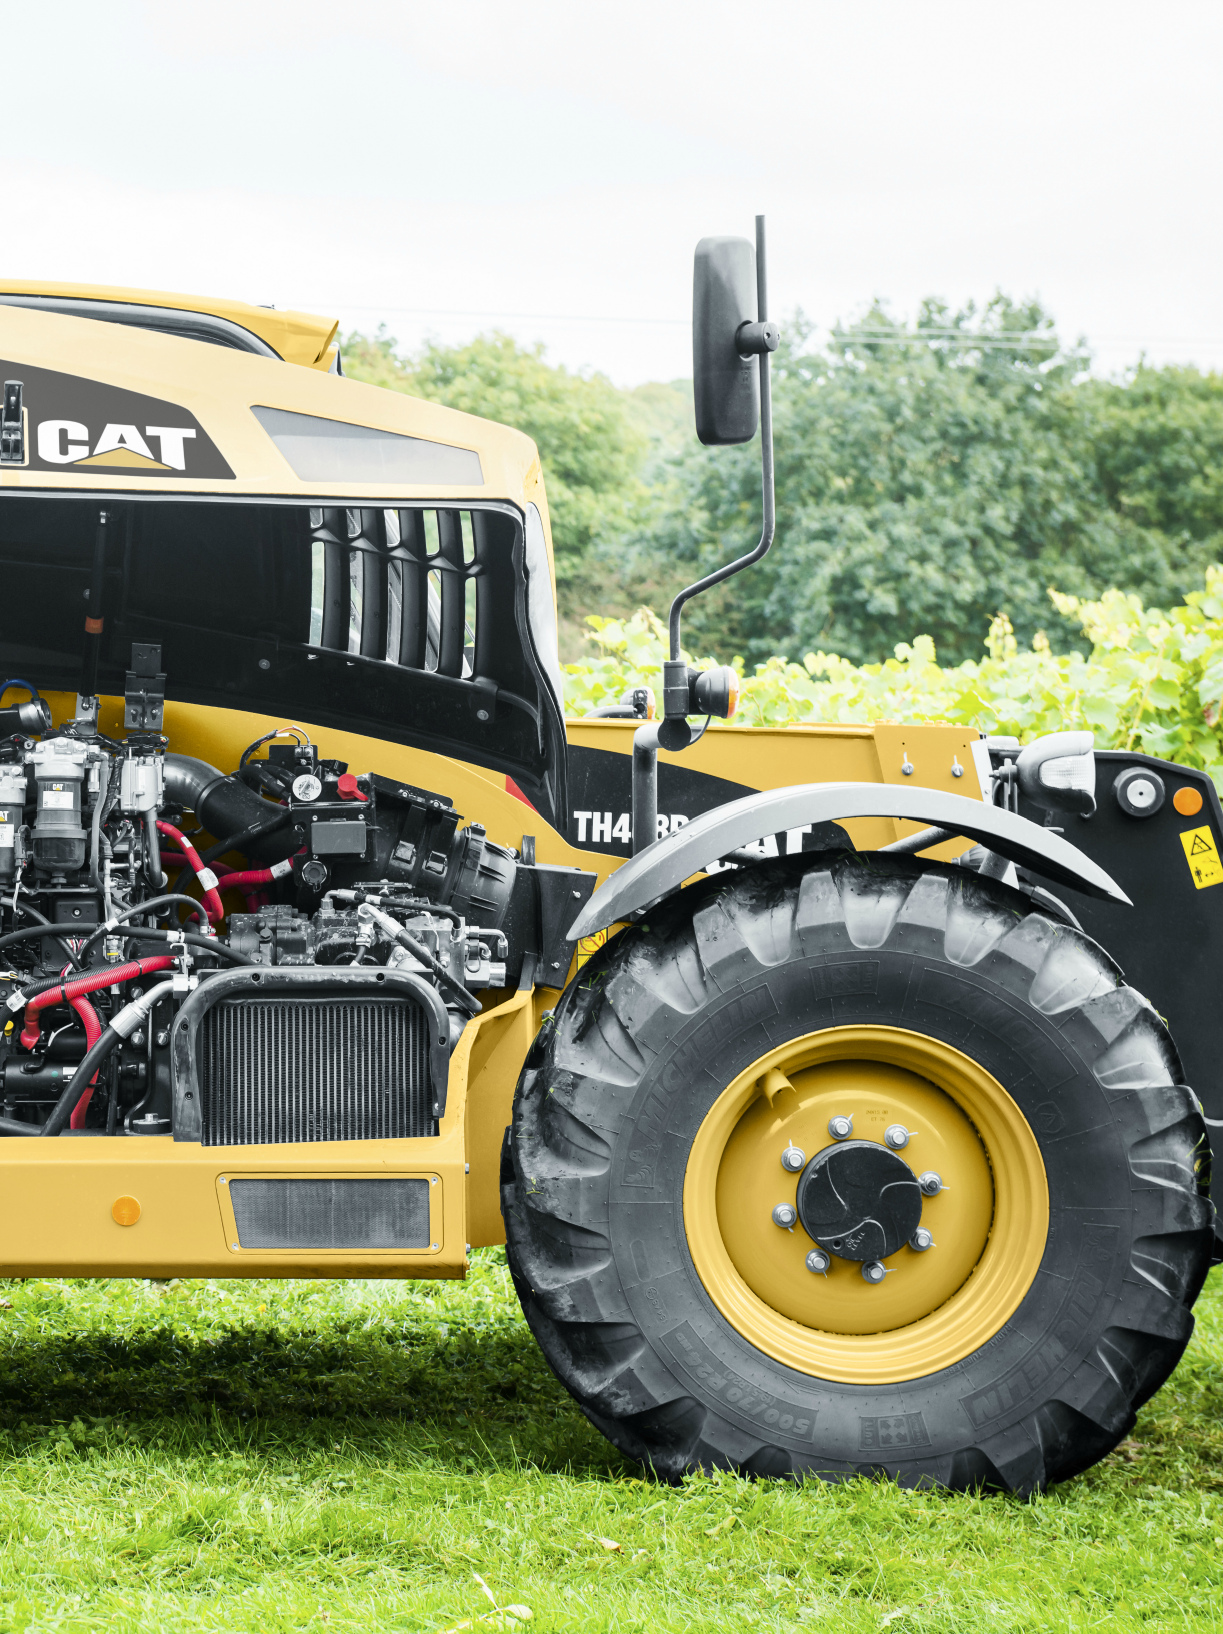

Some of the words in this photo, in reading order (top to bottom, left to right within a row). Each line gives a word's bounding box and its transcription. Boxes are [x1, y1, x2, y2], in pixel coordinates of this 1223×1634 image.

[37, 419, 196, 471] CAT
[53, 783, 64, 791] CAT
[633, 987, 772, 1142] MICHELIN
[965, 1269, 1106, 1425] MICHELIN
